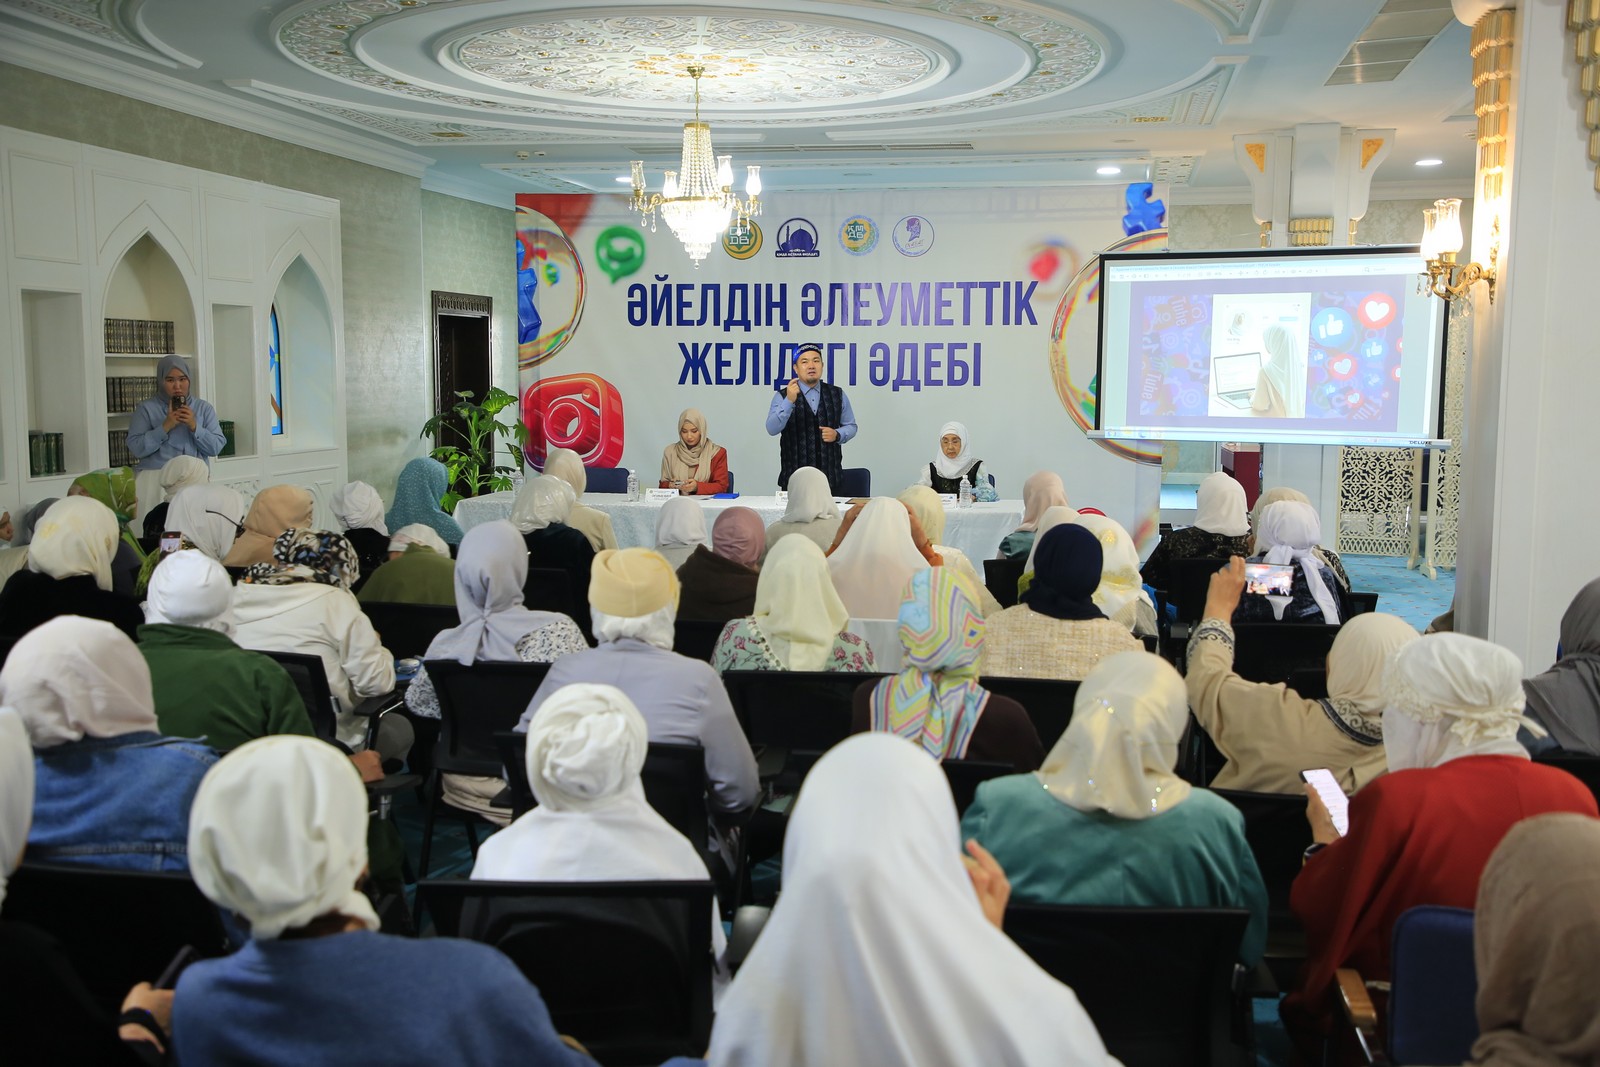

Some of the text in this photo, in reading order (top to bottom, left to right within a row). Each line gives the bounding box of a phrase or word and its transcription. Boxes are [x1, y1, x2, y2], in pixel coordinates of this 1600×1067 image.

[627, 274, 1039, 332] ӘЙЕЛДІҢ ӘЛЕУМЕТТІК
[678, 342, 981, 392] ЖЕЛІДГІ ӘДЕБІ
